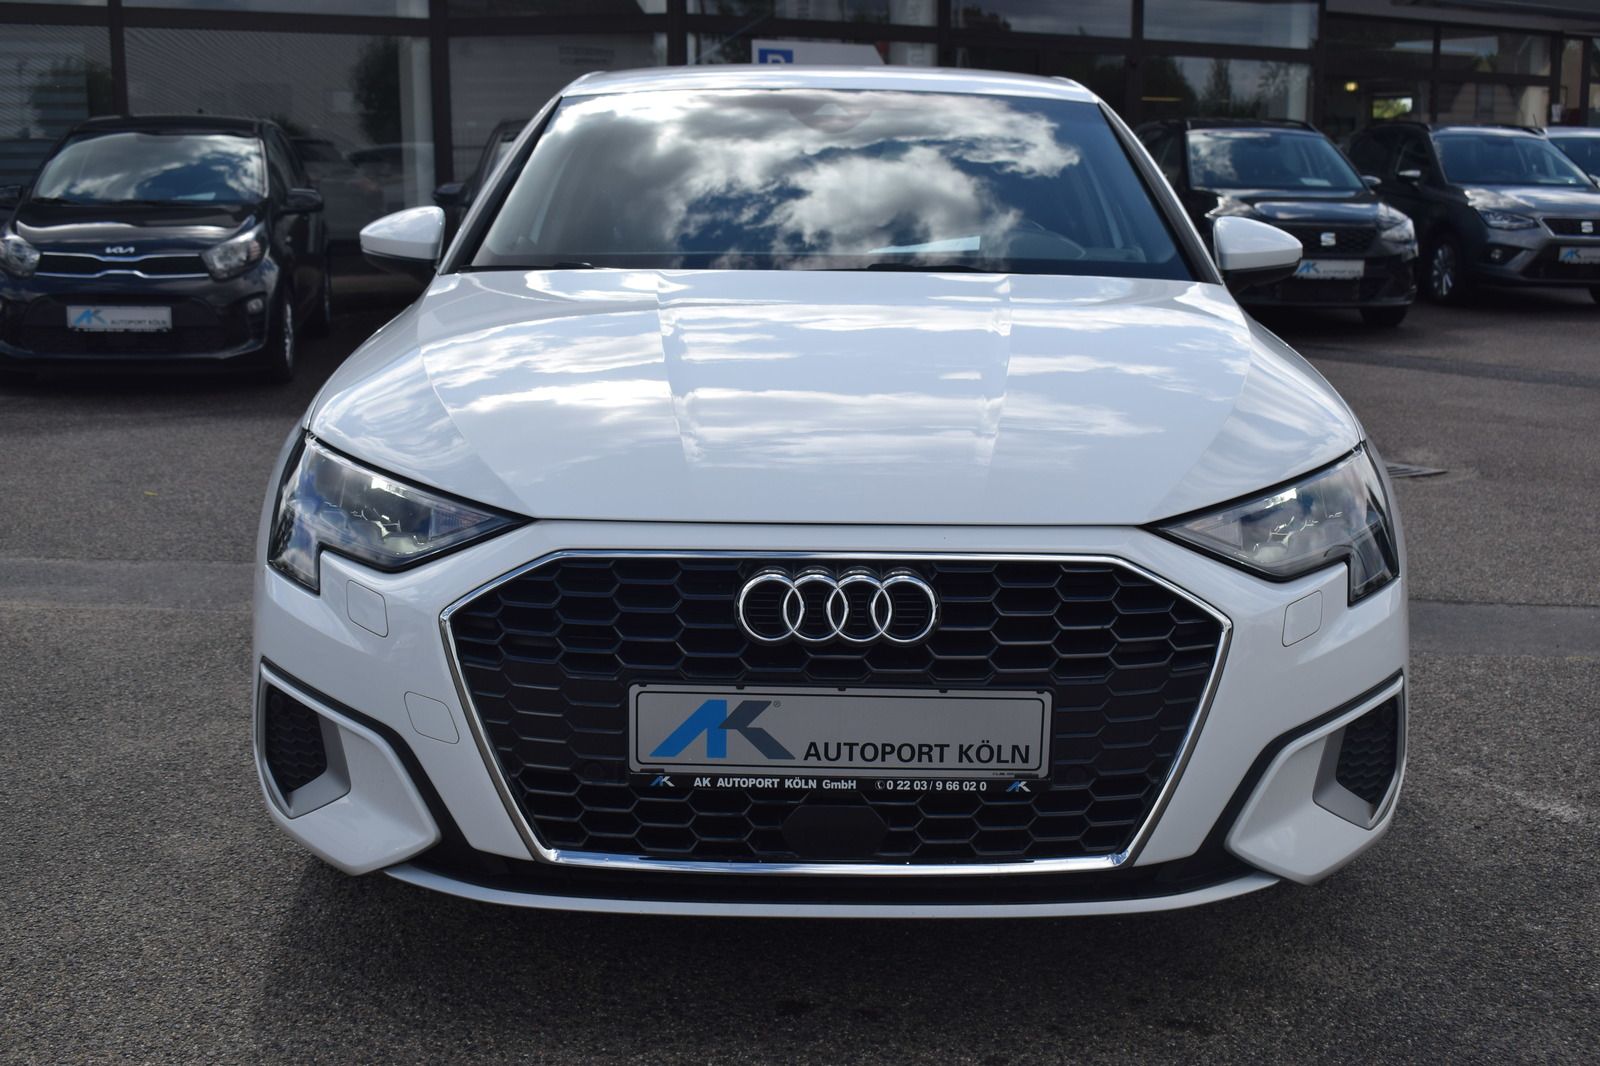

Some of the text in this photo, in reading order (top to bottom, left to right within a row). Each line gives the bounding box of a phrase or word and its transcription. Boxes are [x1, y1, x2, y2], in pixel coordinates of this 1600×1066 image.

[73, 308, 109, 325] AK
[649, 699, 797, 760] AK
[803, 739, 1030, 764] AUTOPORT KÖLN
[650, 775, 675, 787] AK
[693, 776, 857, 790] AK AUTOPORT KÖLN GmbH
[1005, 780, 1031, 792] AK
